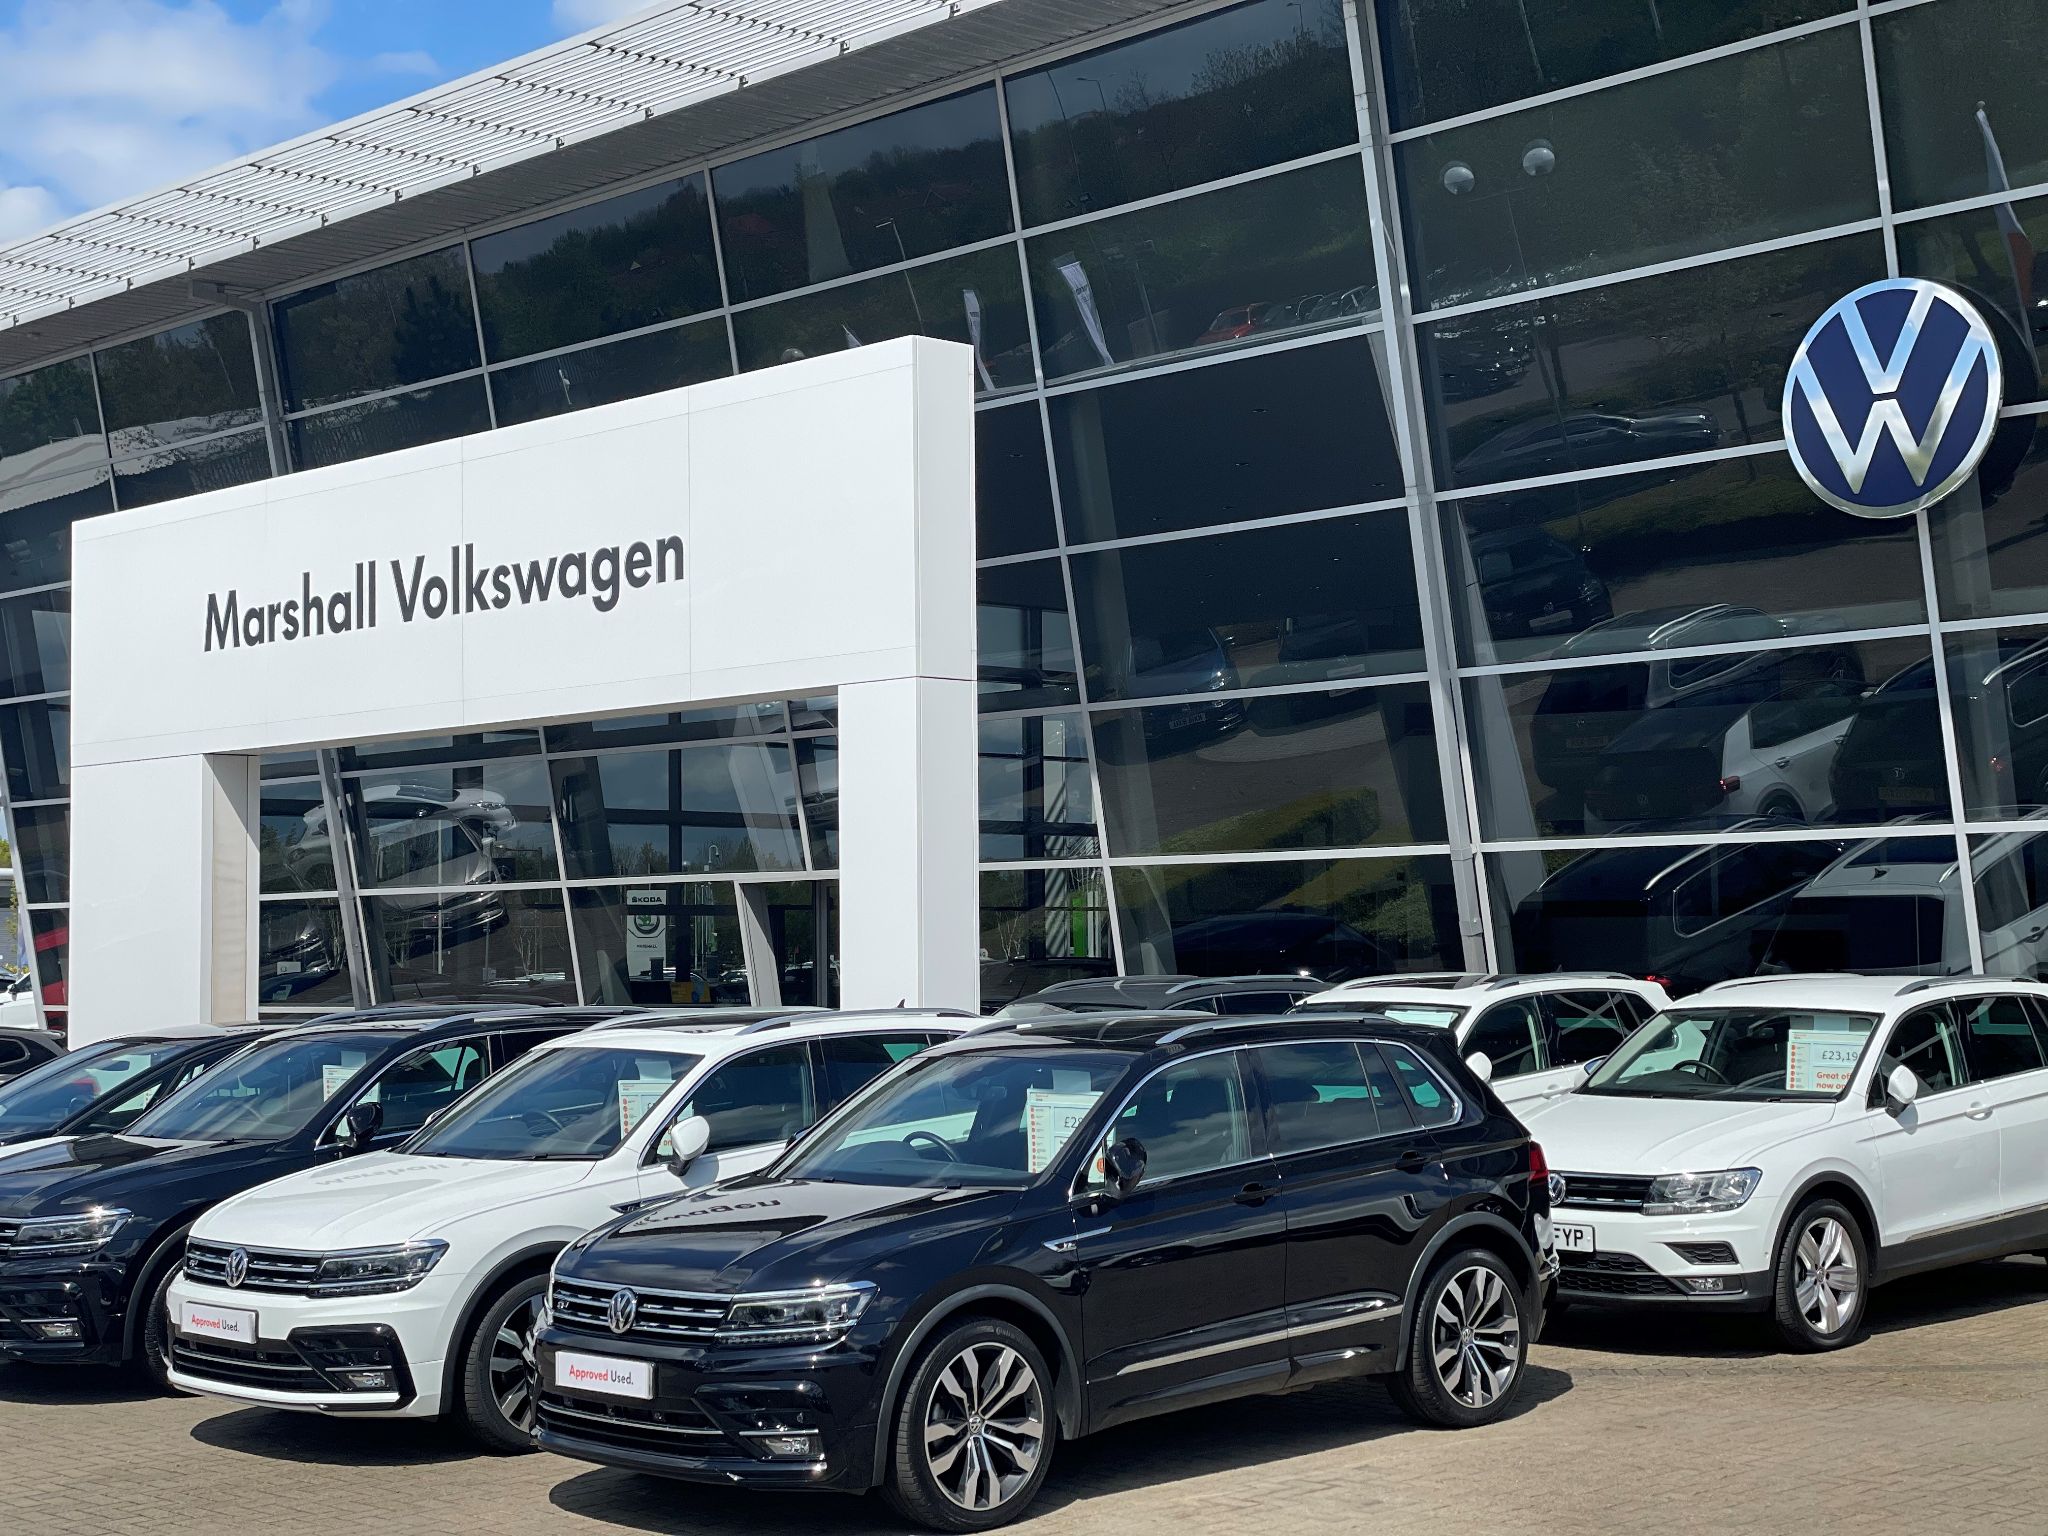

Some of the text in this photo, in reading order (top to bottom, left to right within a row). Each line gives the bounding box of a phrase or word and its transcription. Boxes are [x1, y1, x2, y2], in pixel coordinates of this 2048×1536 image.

[204, 535, 684, 652] Marshall Volkswagen
[1822, 1050, 1859, 1062] £23,19
[1816, 1071, 1840, 1080] Great
[191, 1313, 221, 1329] Approved
[569, 1364, 634, 1385] Approved Used.
